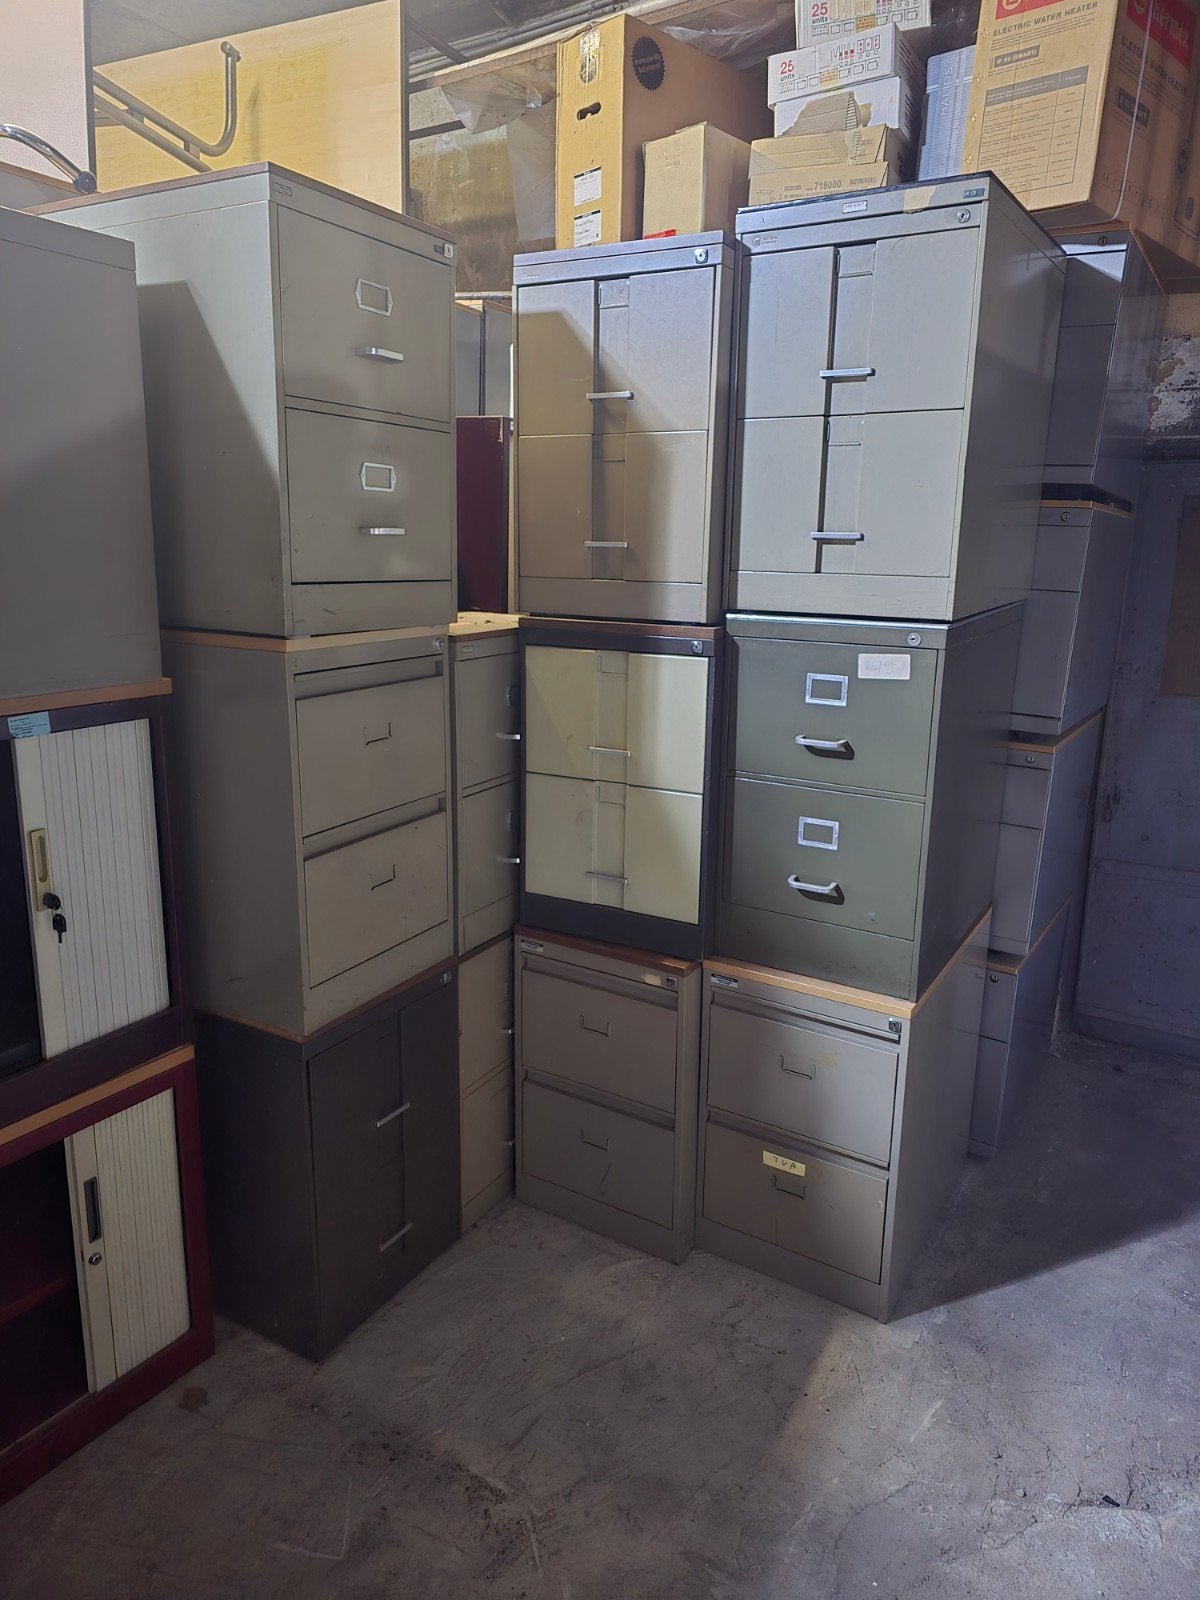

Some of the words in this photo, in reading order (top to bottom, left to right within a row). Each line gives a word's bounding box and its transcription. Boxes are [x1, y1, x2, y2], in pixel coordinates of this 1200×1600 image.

[812, 2, 828, 17] 25
[811, 16, 829, 24] units
[992, 20, 1032, 37] ELECTRIC
[1033, 11, 1062, 25] WATER
[1064, 1, 1098, 17] HEATER
[780, 60, 795, 75] 25
[780, 73, 795, 82] units
[940, 66, 953, 117] HALIOS
